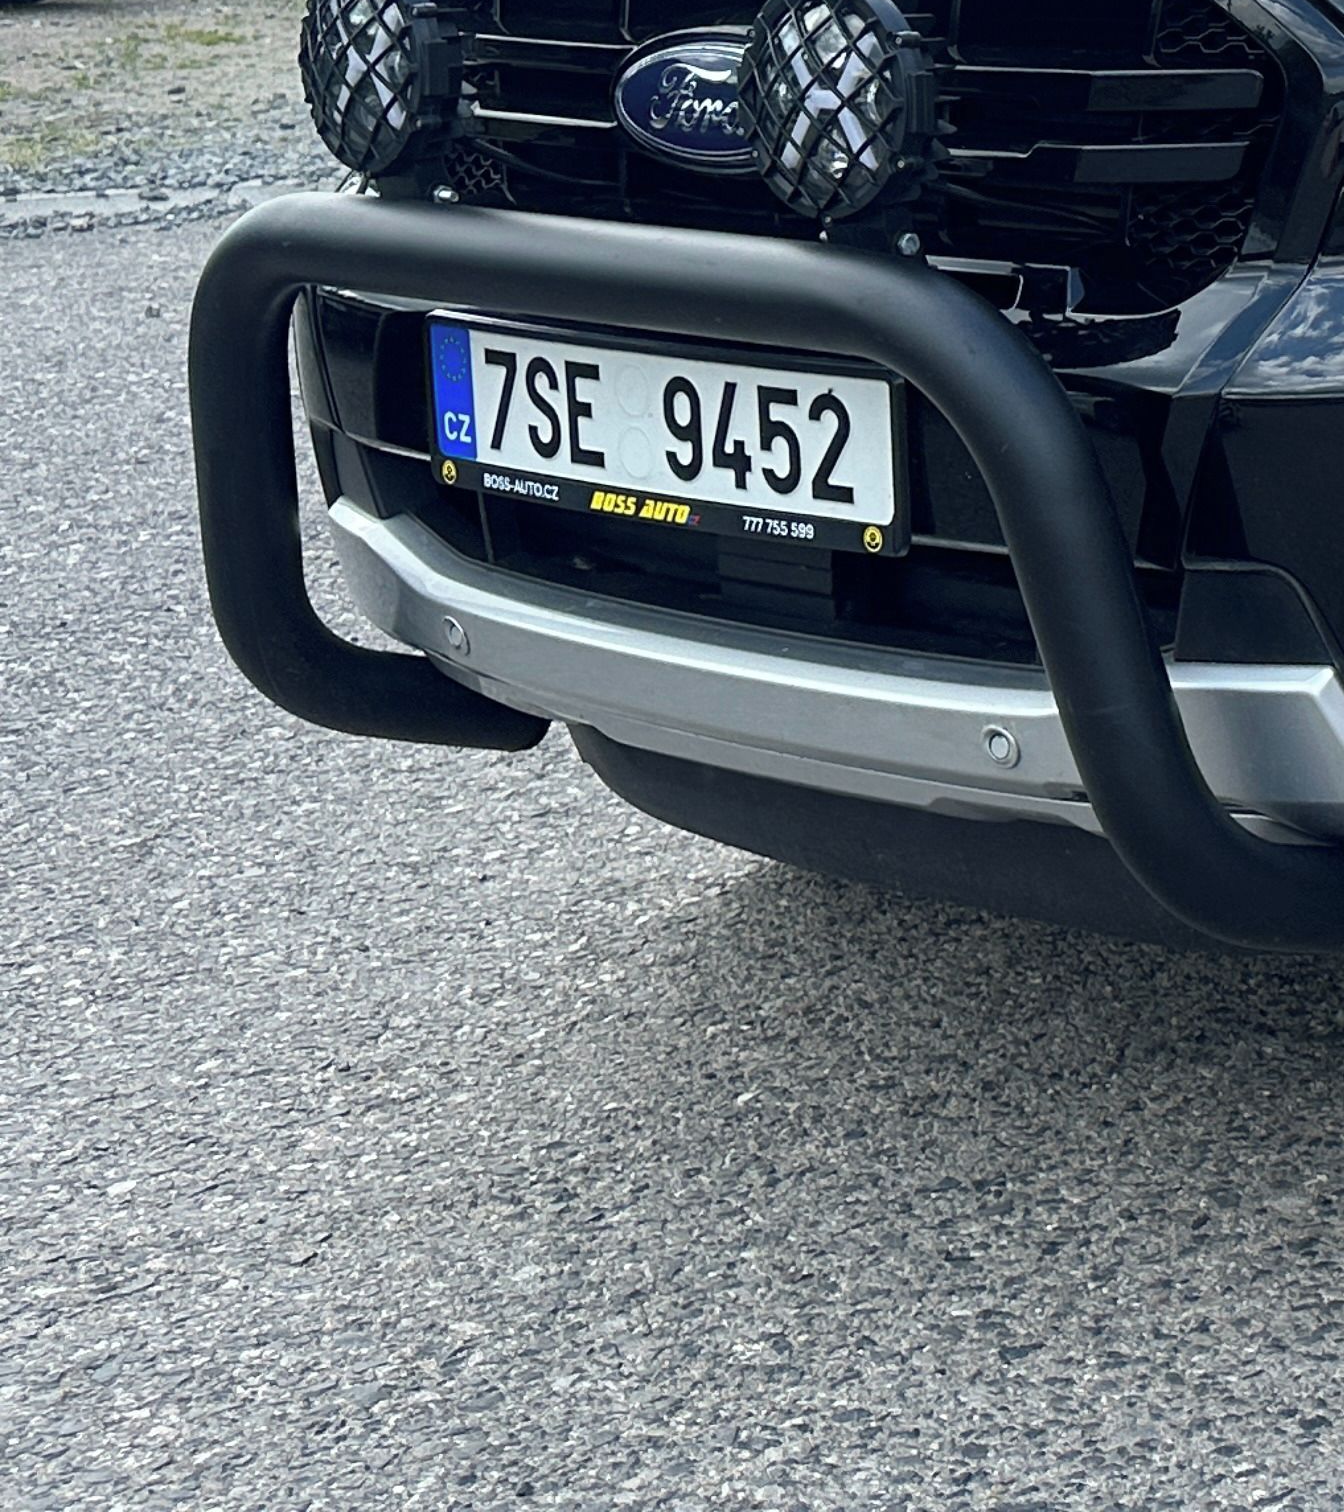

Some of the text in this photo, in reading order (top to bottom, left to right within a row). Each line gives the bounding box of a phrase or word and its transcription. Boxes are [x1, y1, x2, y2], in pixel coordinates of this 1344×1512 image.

[443, 410, 472, 444] CZ
[484, 347, 855, 505] 7SE 9452
[483, 472, 560, 502] BOSS-AUTO.CZ
[589, 490, 637, 517] BOSS
[637, 498, 691, 526] AUTO
[742, 515, 815, 540] 777 755 599
